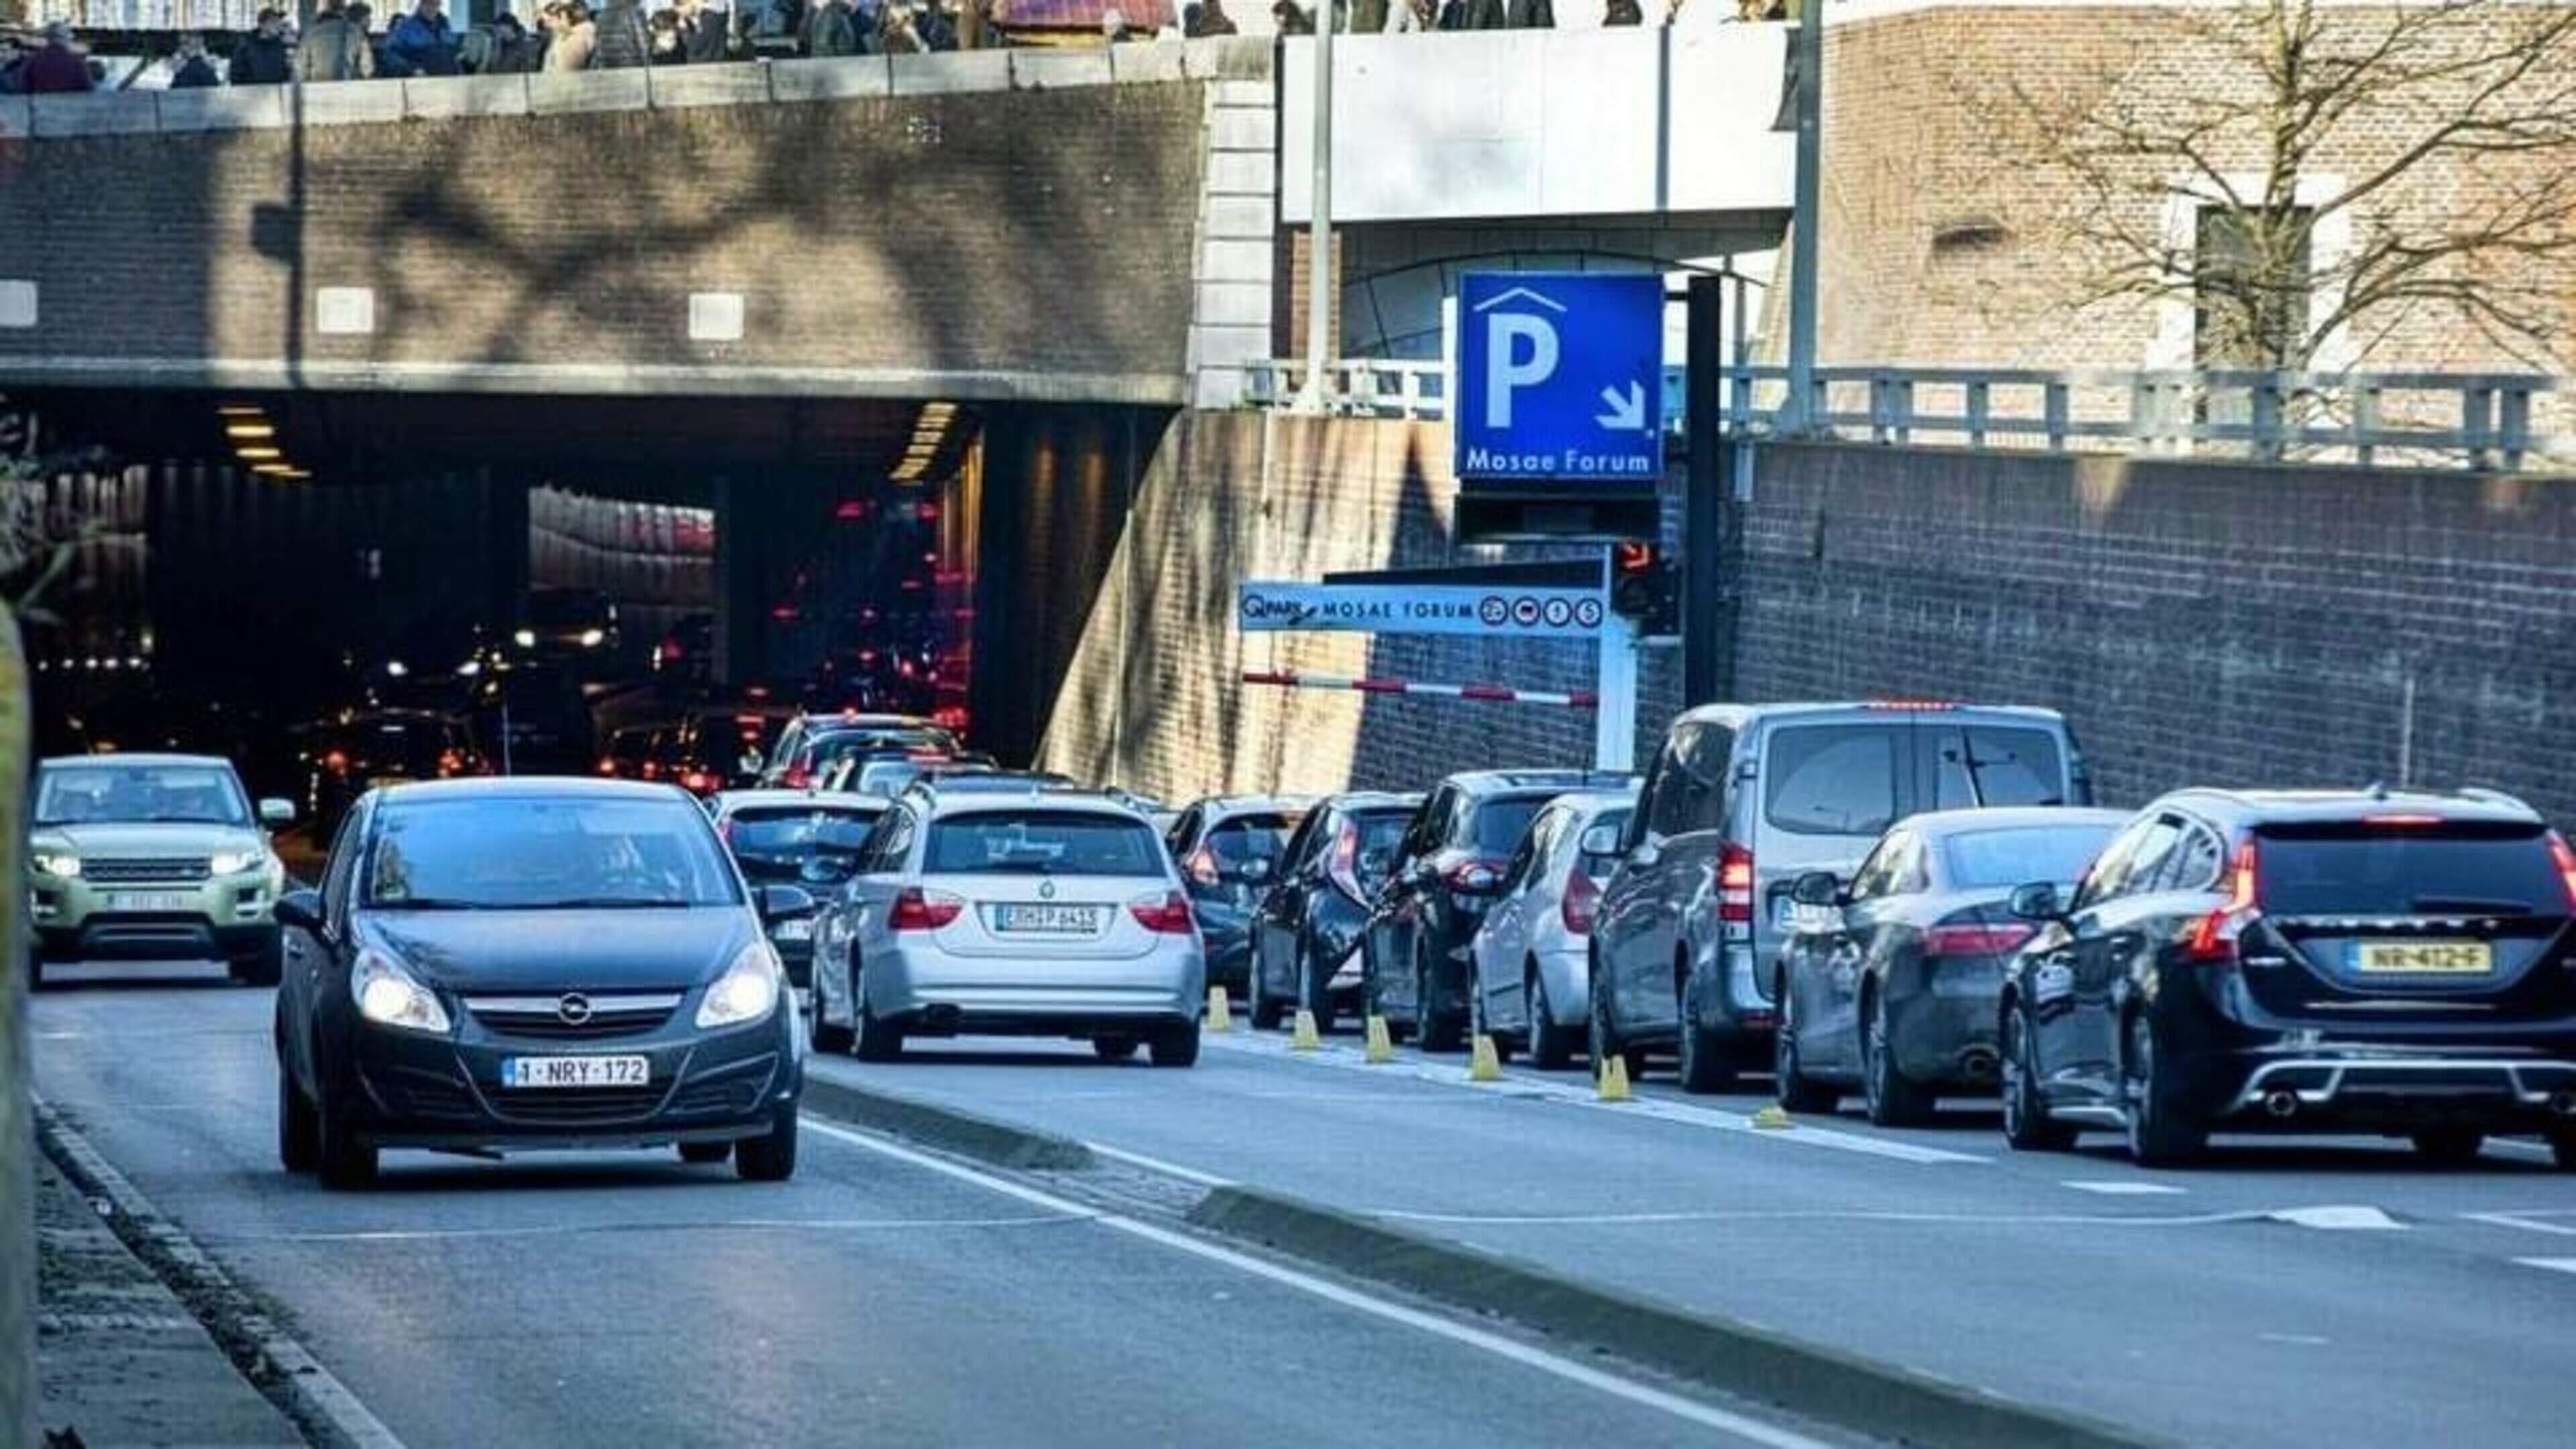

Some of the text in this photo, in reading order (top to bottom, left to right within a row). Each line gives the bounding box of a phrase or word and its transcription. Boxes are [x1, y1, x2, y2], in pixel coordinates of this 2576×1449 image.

[1487, 313, 1559, 428] P
[1467, 446, 1649, 472] Mosae Forum
[1323, 600, 1391, 618] MOSAE
[1404, 601, 1474, 619] FORUM
[521, 1061, 643, 1083] 1-NRY-172
